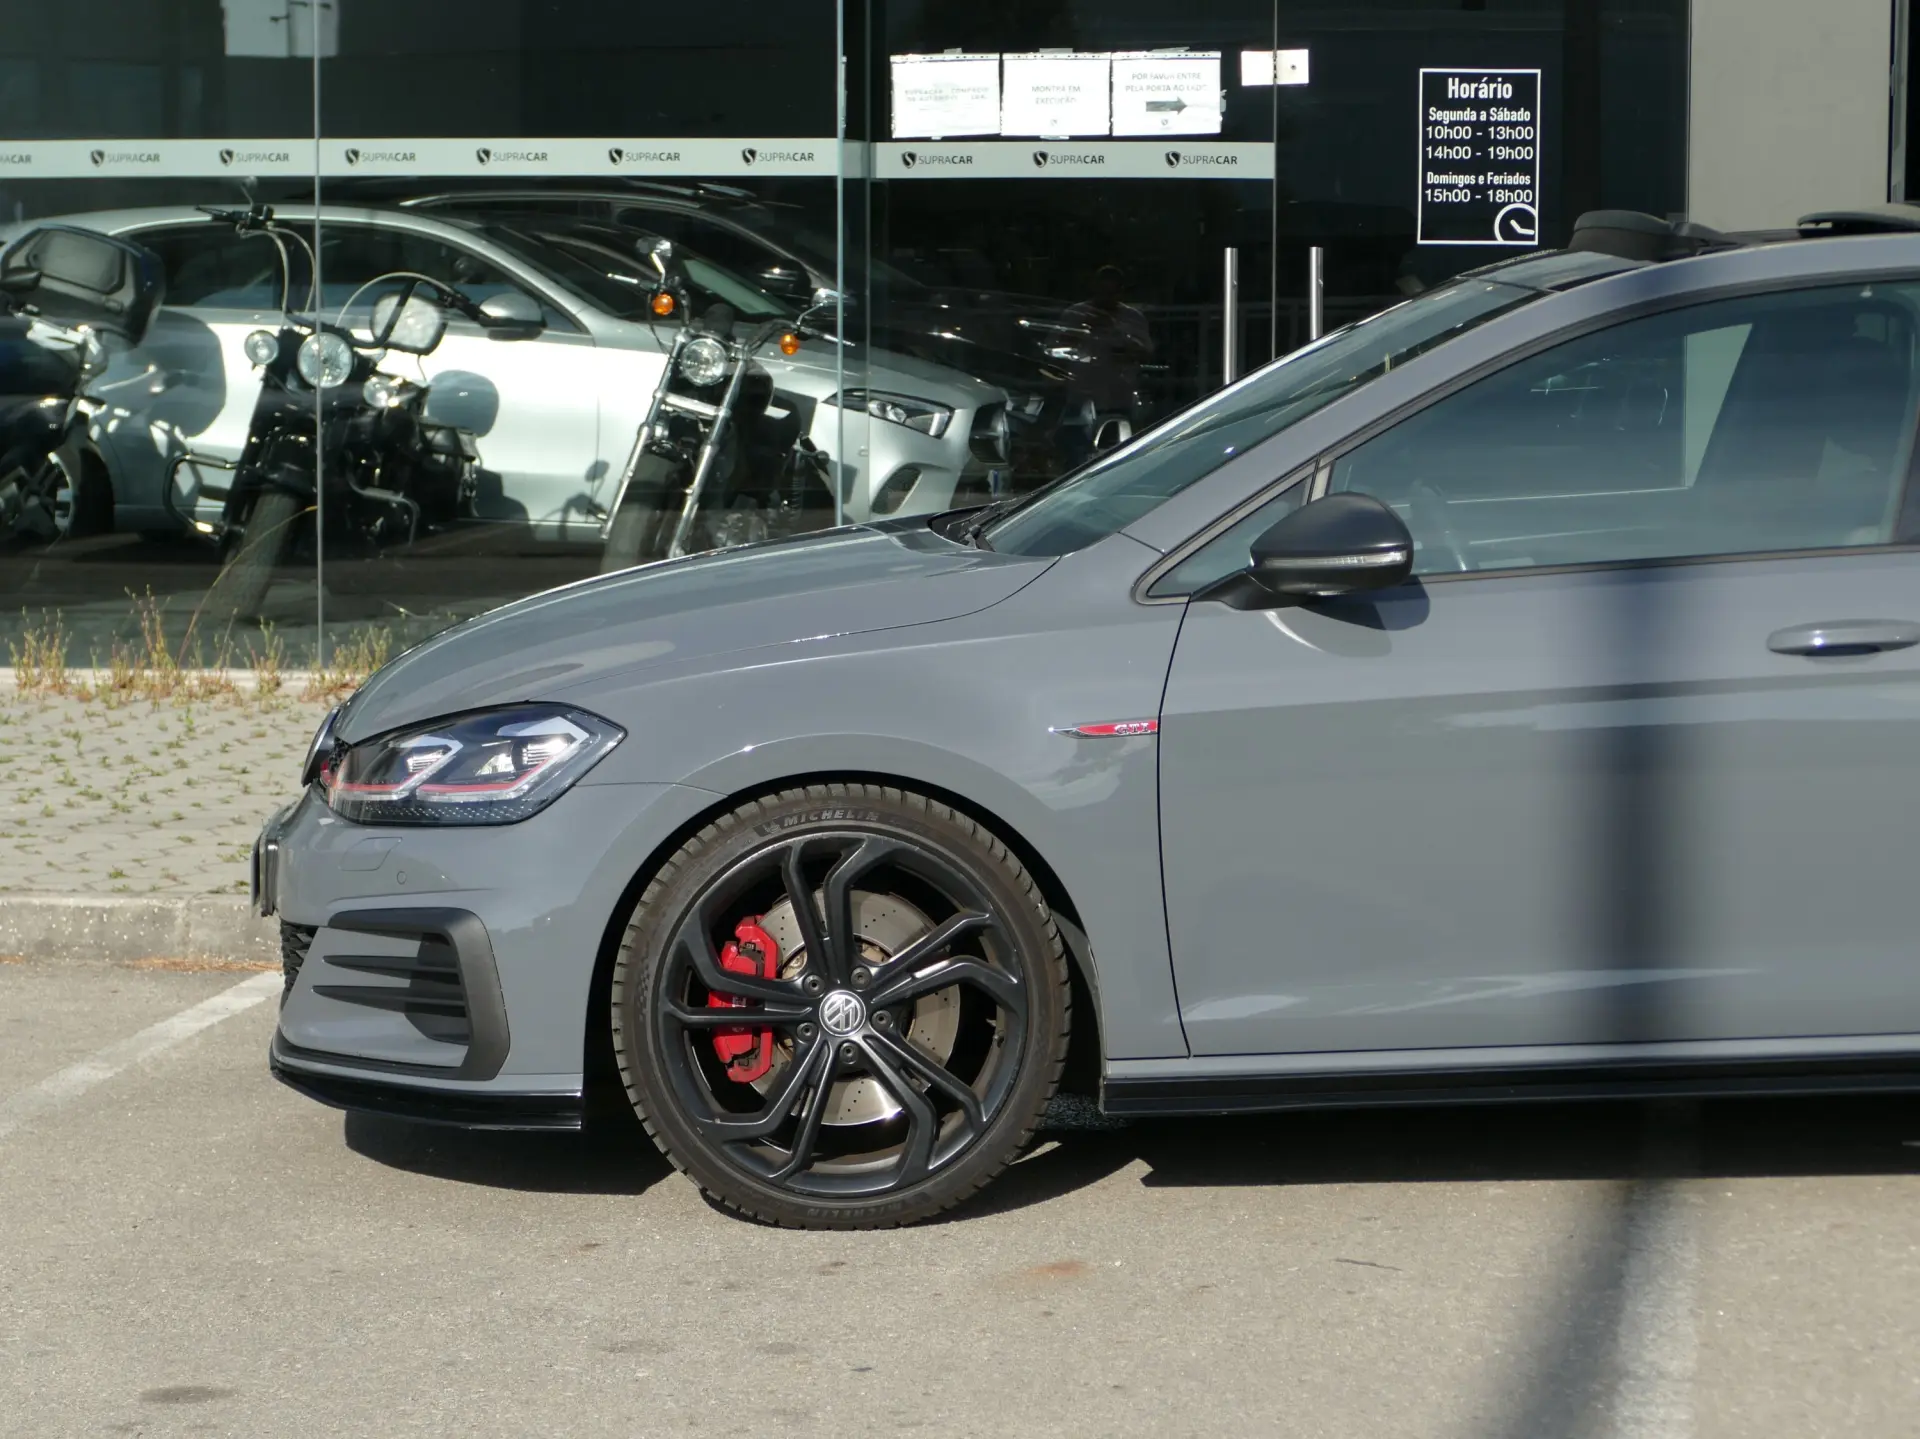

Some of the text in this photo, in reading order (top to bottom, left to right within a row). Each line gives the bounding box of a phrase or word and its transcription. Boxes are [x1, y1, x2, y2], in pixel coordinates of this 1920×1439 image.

[1448, 77, 1512, 99] Horário
[1428, 107, 1530, 123] Segunda a Sábado
[1426, 126, 1472, 139] 10h00
[1488, 126, 1534, 140] 13h00
[106, 152, 160, 162] SUPRACAR
[236, 152, 290, 162] SUPRACAR
[361, 152, 416, 162] SUPRACAR
[493, 152, 548, 162] SUPRACAR
[626, 152, 680, 162] SUPRACAR
[759, 152, 814, 162] SUPRACAR
[1426, 146, 1472, 159] 14h00
[1488, 146, 1534, 160] 19h00
[918, 155, 973, 165] SUPRACAR
[1050, 154, 1105, 164] SUPRACAR
[1182, 155, 1238, 165] SUPRACAR
[1427, 172, 1530, 187] Domingos e Feriados
[1426, 189, 1470, 202] 15h00
[1488, 190, 1532, 202] 18h00
[1114, 722, 1150, 735] GTI
[784, 809, 878, 828] MICHELIN
